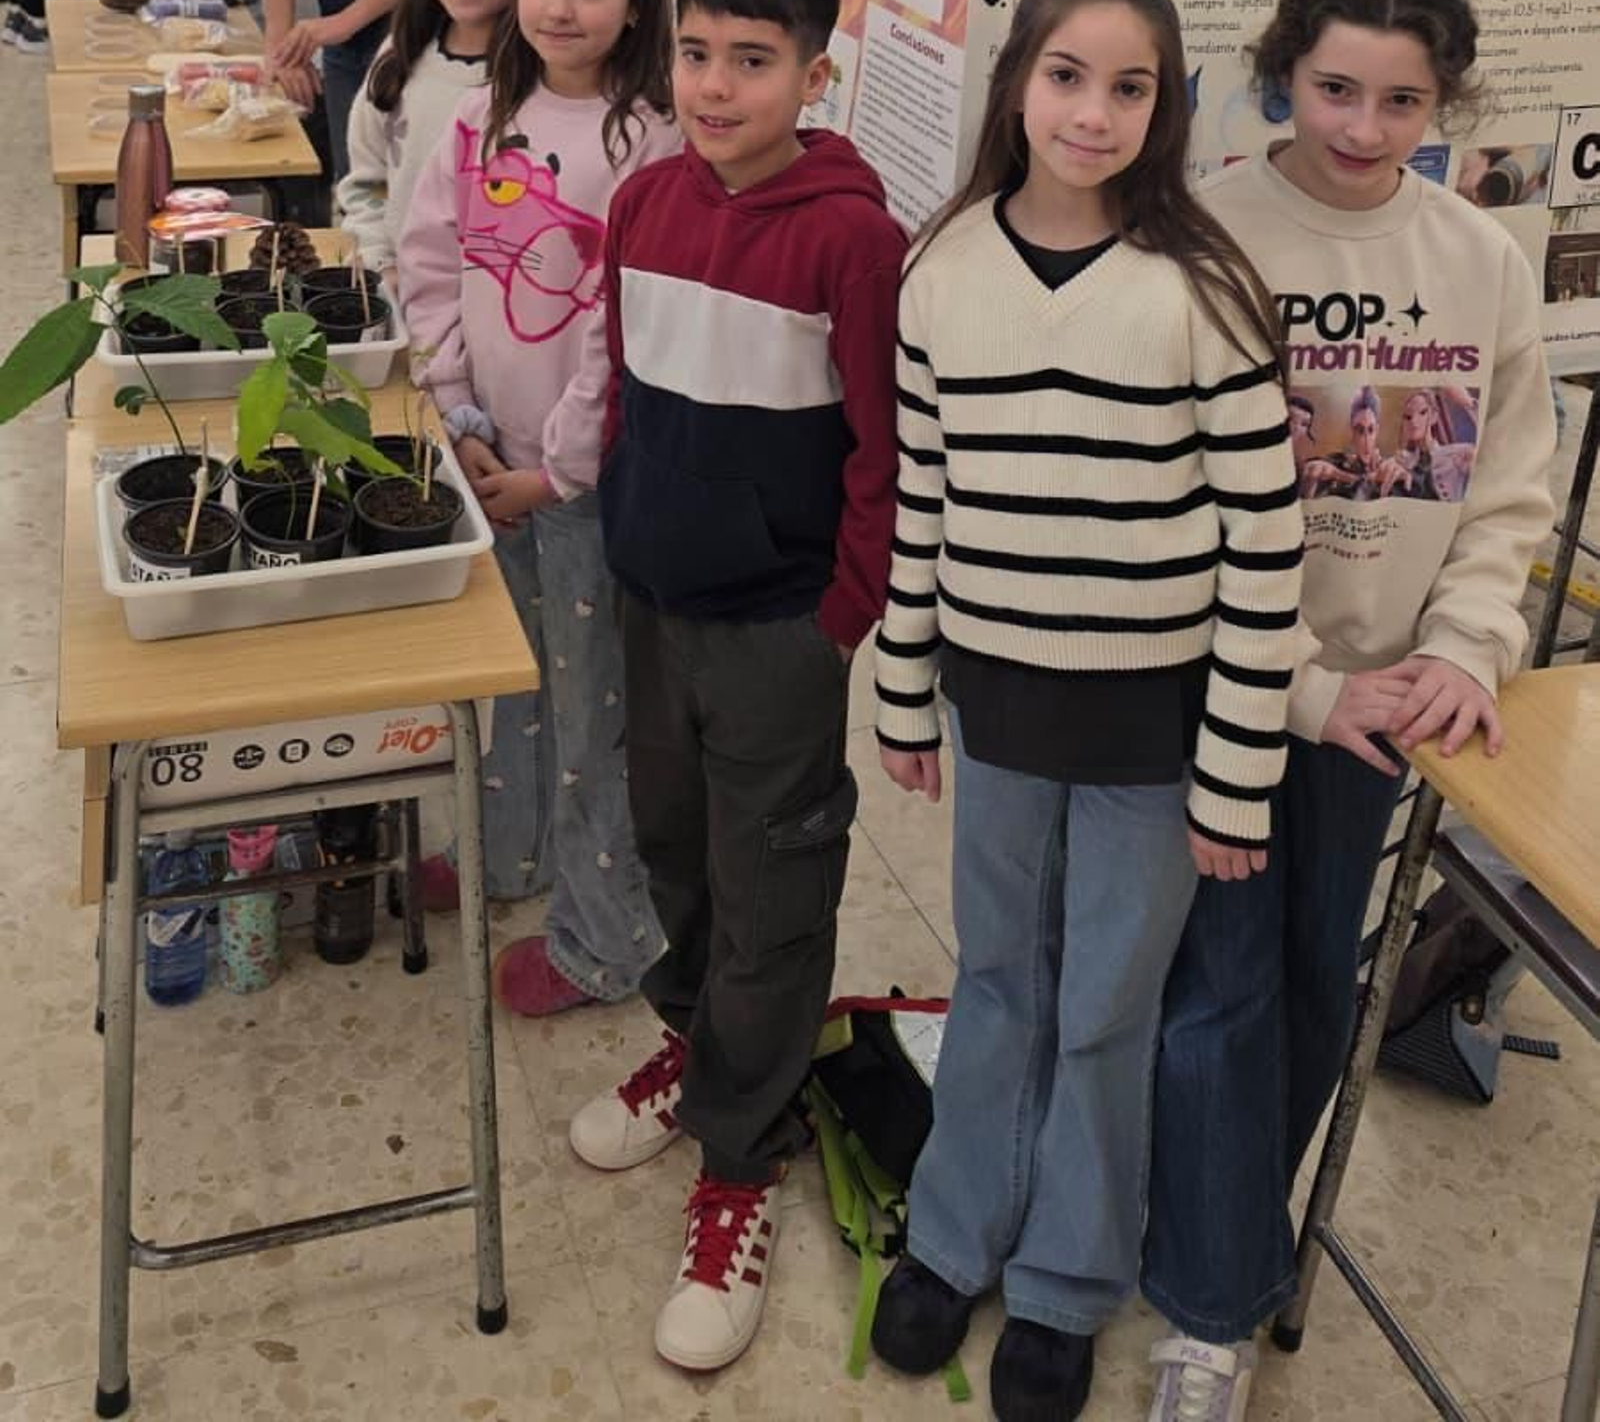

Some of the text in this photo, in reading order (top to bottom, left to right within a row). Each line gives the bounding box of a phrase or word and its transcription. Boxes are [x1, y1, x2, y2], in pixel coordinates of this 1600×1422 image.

[890, 22, 946, 66] Conclusiones
[1187, 43, 1237, 56] mediante
[1567, 112, 1581, 126] 17
[151, 753, 204, 786] 80
[1180, 1347, 1211, 1365] FILA
